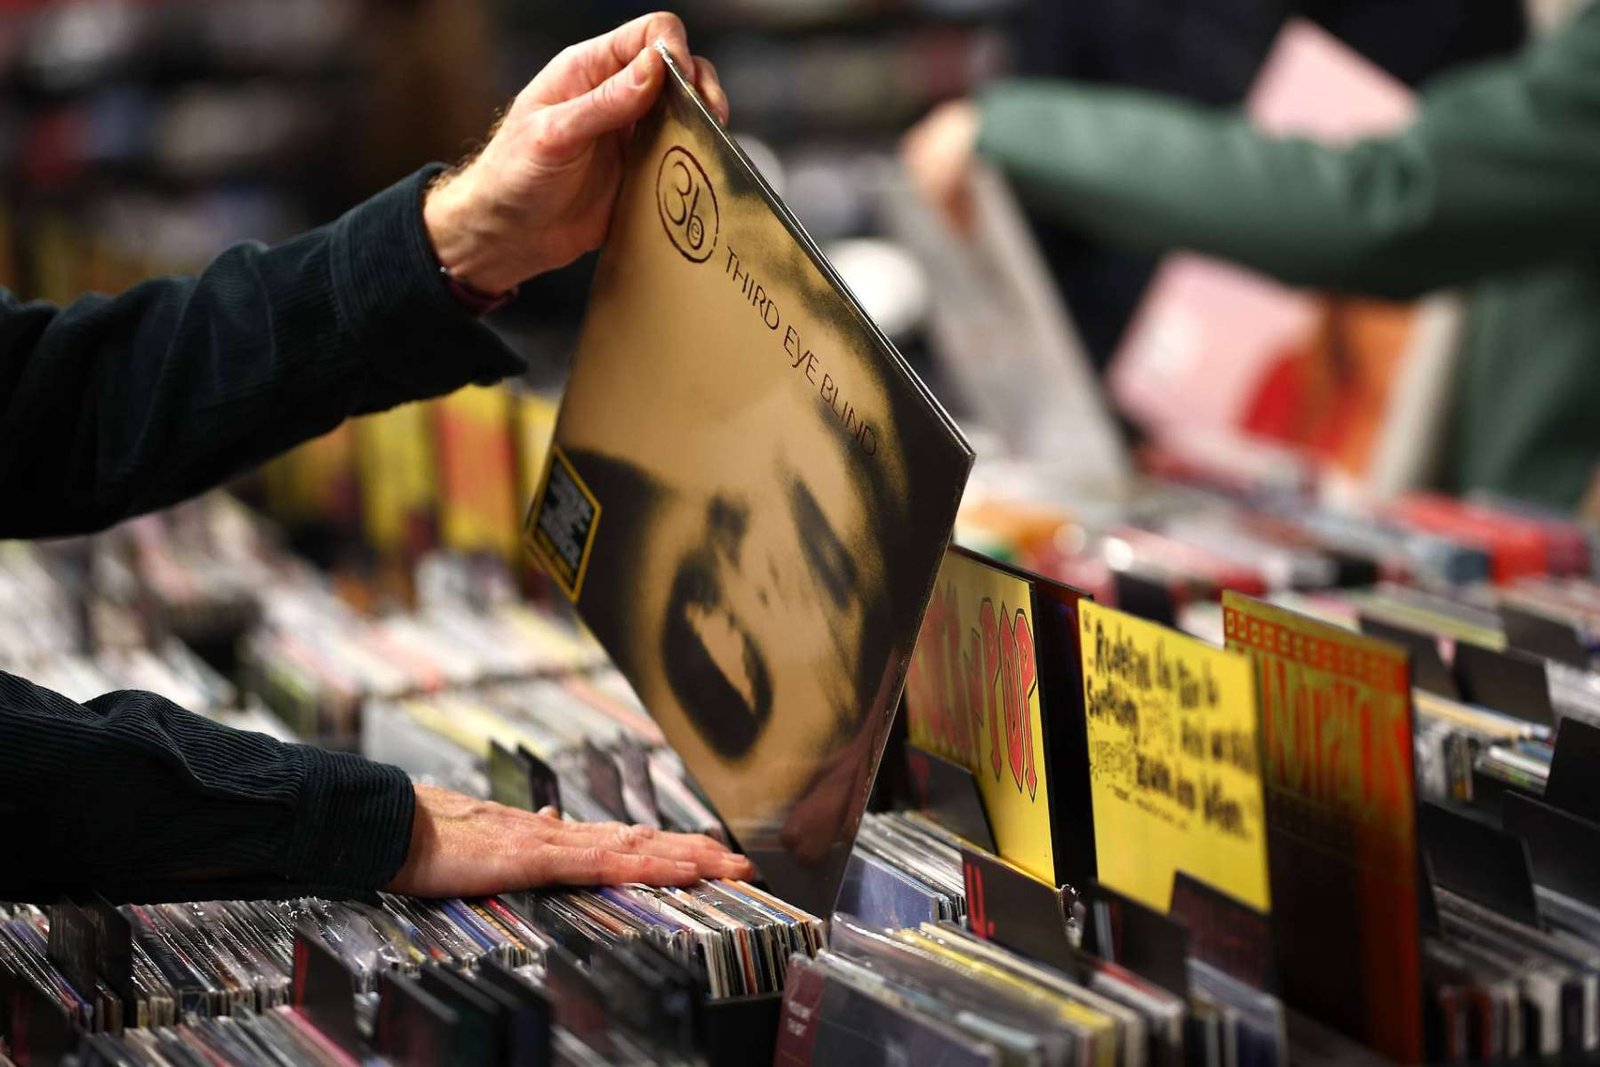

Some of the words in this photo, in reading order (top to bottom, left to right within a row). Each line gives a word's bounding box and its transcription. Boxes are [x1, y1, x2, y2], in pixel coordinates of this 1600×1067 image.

[725, 246, 780, 331] THIRD
[783, 325, 819, 386] EYE
[820, 373, 877, 457] BLIND
